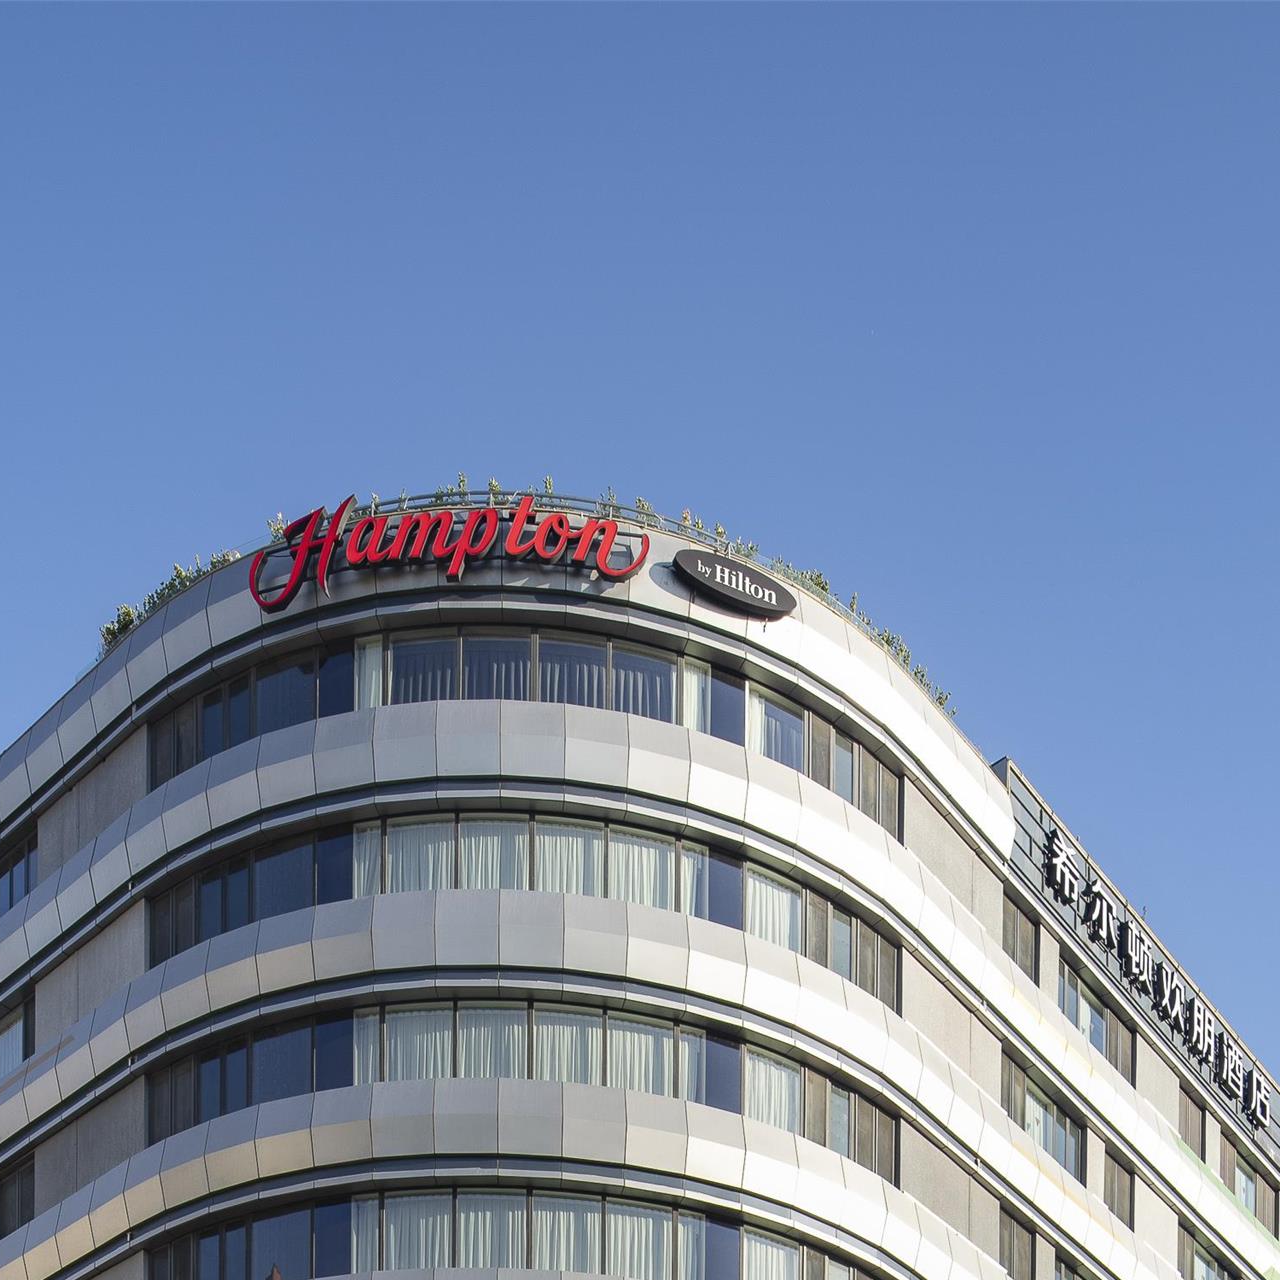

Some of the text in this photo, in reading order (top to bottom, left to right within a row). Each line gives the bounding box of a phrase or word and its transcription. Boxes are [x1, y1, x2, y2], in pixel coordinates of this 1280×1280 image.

[249, 494, 650, 611] Hampton
[697, 559, 777, 606] by Hilton
[1049, 832, 1271, 1129] 希尔顿欢朋酒店
